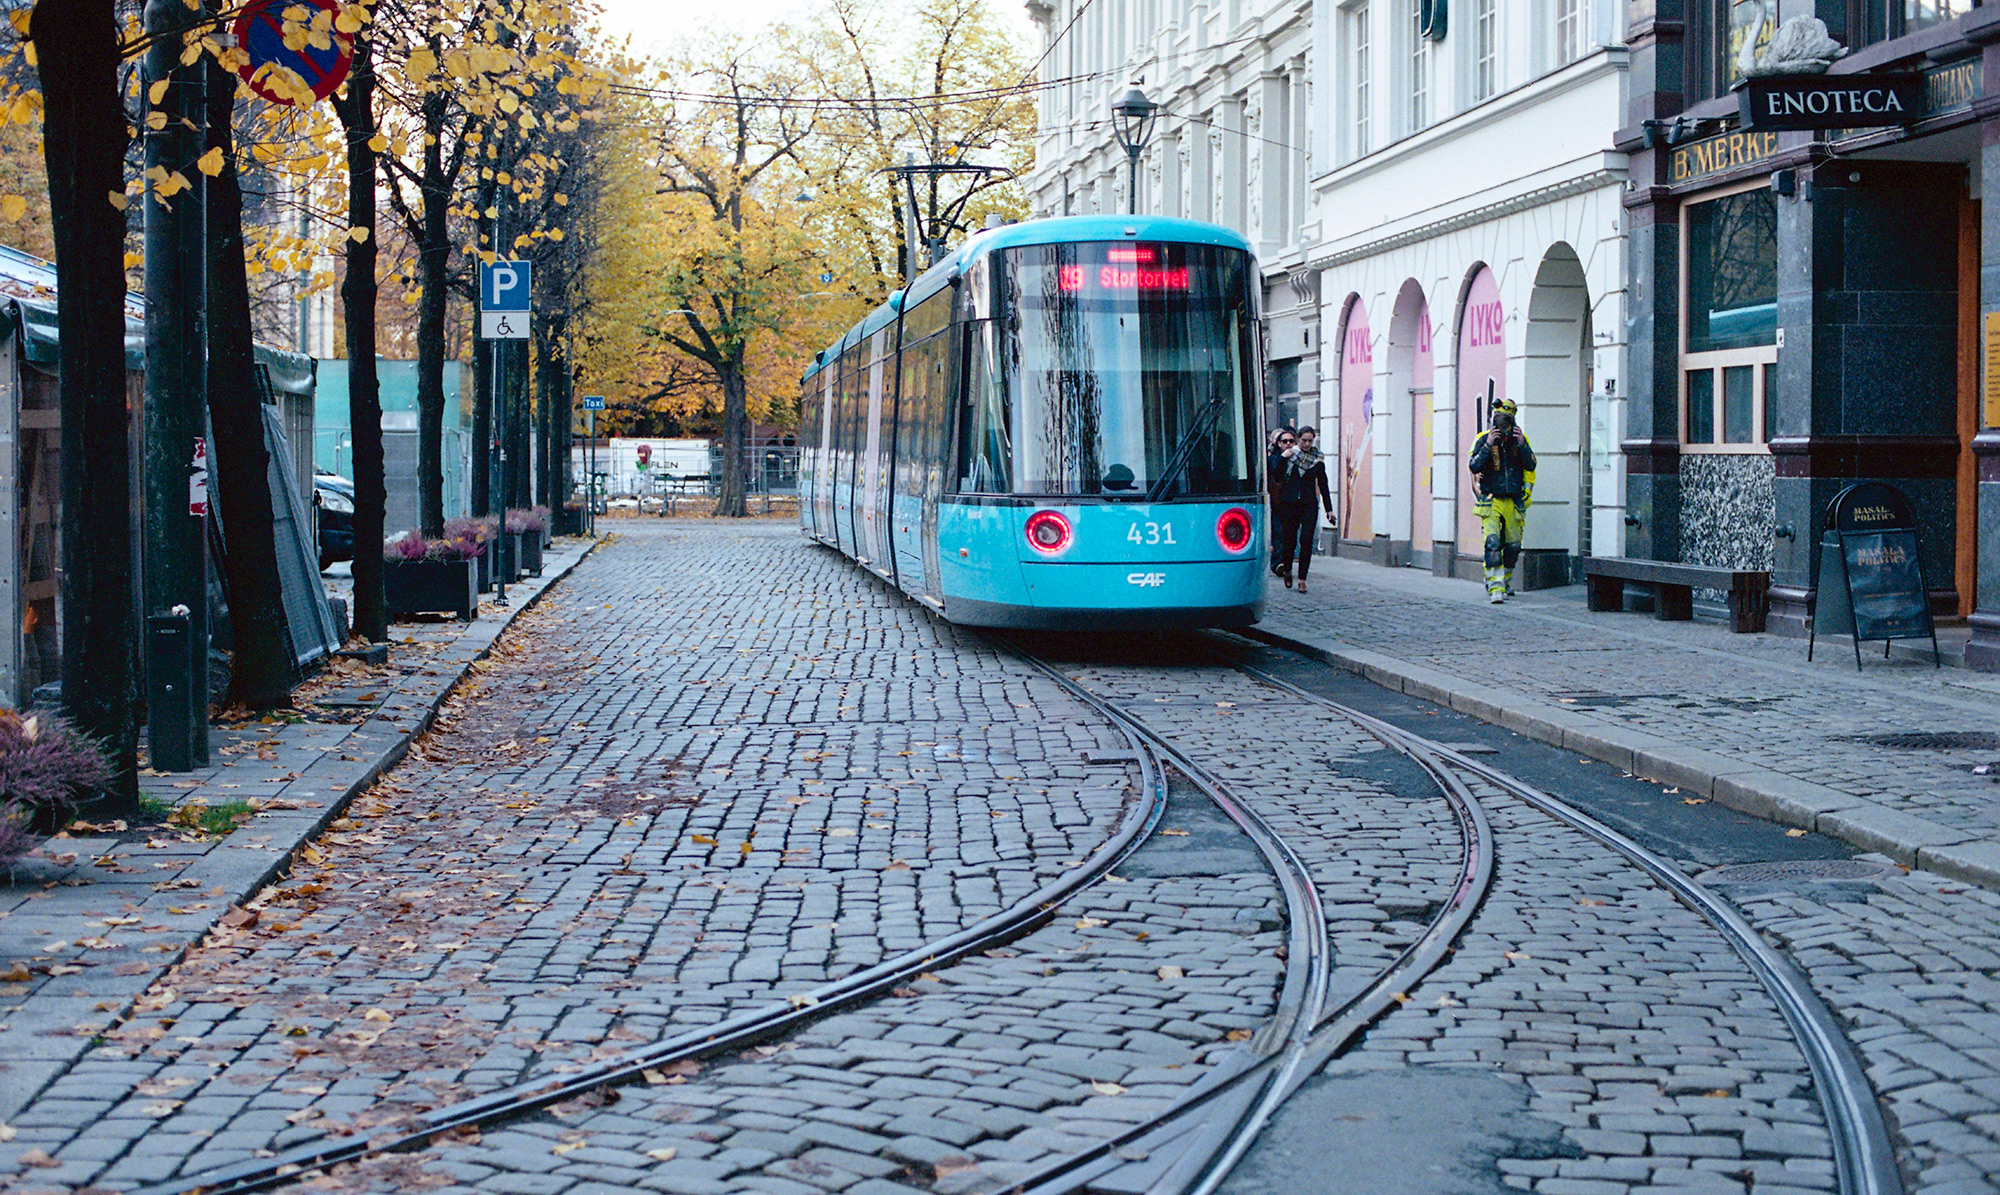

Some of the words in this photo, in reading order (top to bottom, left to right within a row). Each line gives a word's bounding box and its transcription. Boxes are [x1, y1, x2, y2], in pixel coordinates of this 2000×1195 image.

[1766, 88, 1904, 116] ENOTECA
[1674, 150, 1692, 181] B.
[493, 268, 518, 305] P
[1101, 265, 1189, 288] Stortorvet
[1421, 314, 1432, 353] LY
[1471, 301, 1503, 348] LYKO
[585, 399, 604, 408] Taxi
[1127, 522, 1176, 545] 431
[1127, 573, 1166, 588] CAF
